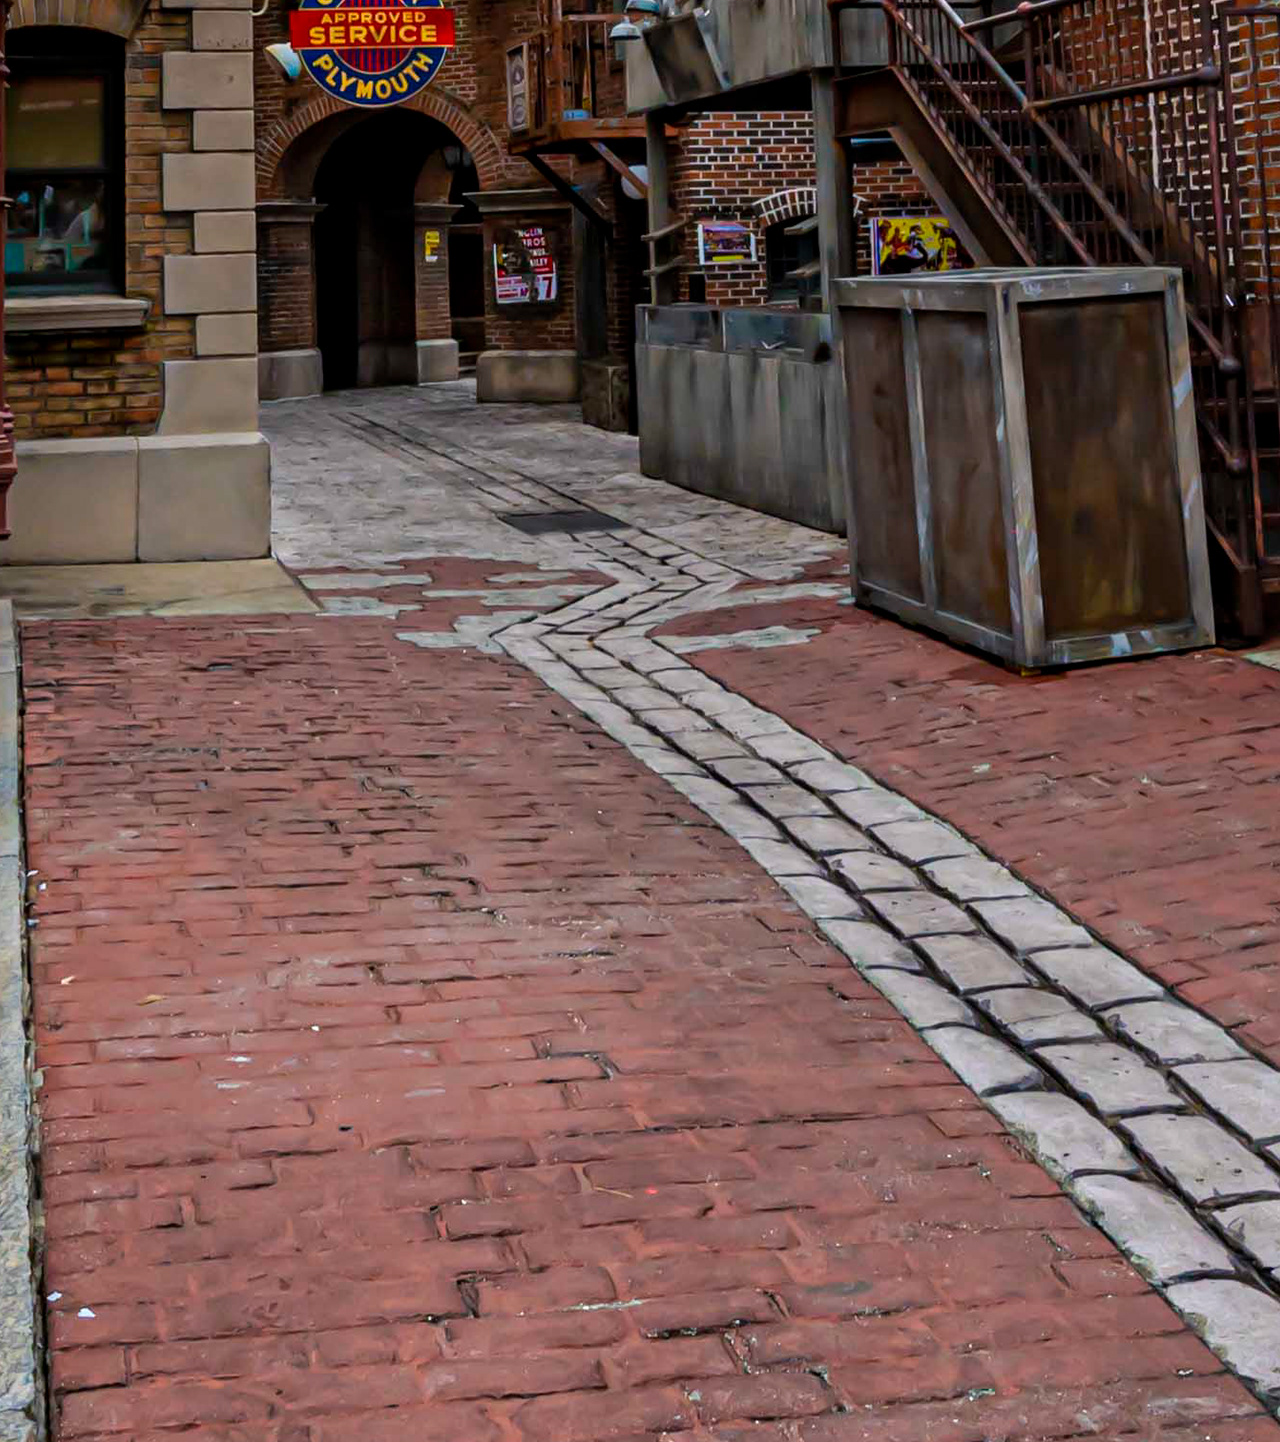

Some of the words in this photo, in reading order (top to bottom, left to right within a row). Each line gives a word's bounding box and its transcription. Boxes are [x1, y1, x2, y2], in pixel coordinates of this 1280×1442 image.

[321, 11, 426, 24] APPROVED
[309, 25, 437, 45] SERVICE
[312, 51, 434, 99] PLYMOUTH
